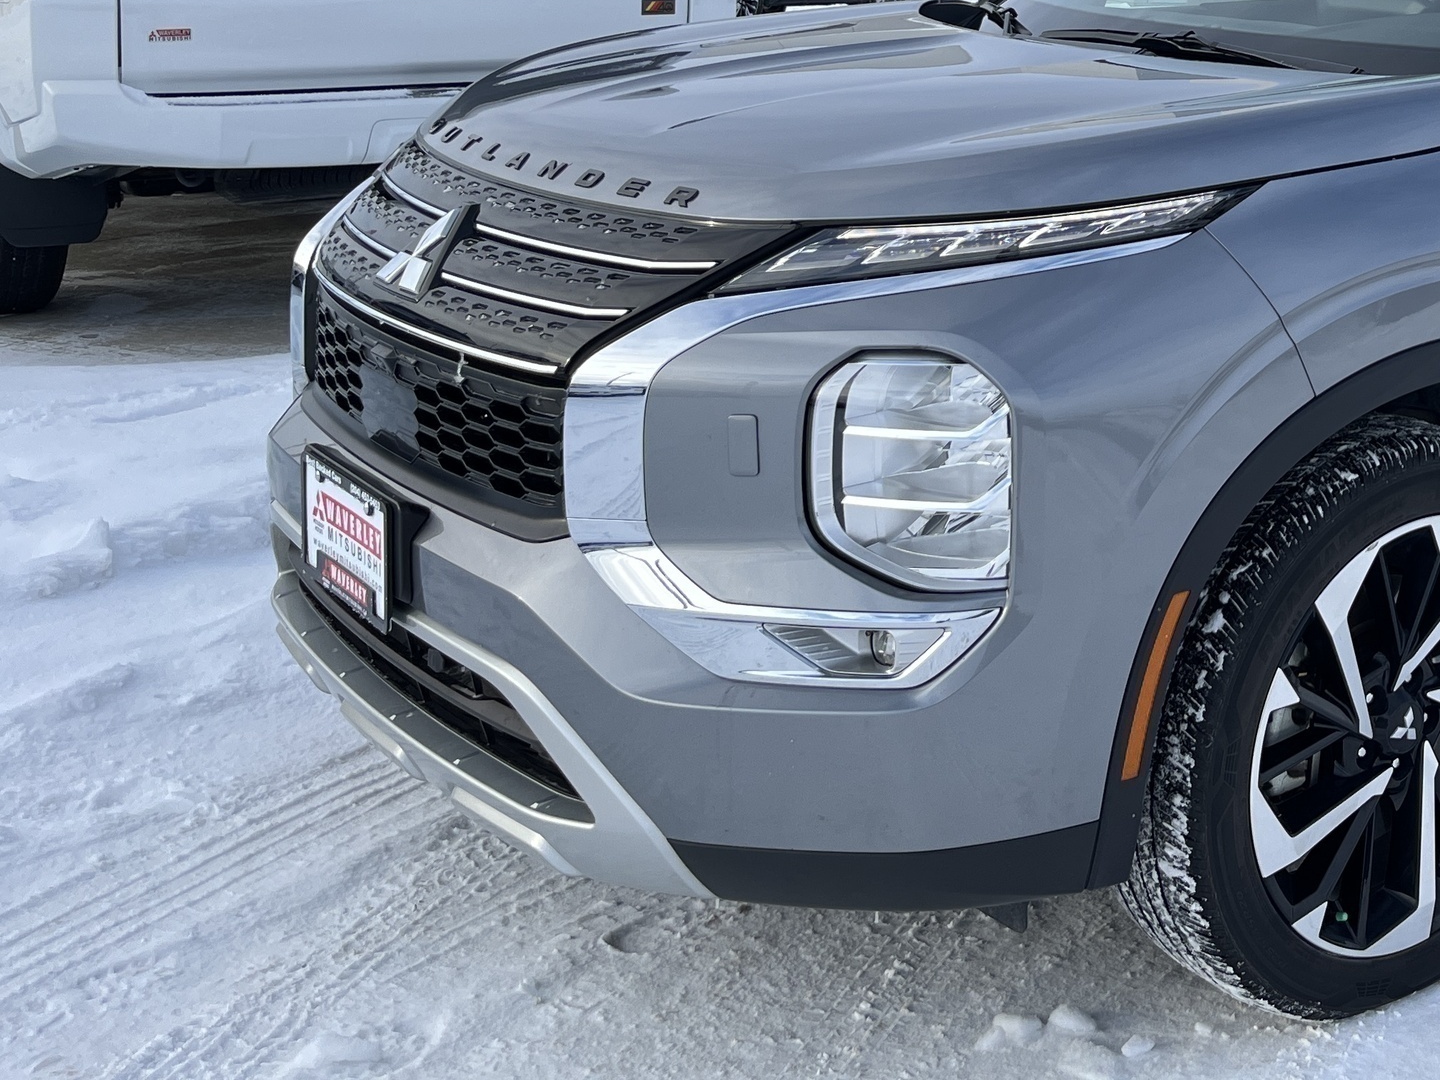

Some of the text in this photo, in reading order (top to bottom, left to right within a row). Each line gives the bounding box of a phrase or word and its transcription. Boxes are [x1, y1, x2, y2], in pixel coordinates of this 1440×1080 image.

[429, 118, 700, 208] OUTLANDER
[325, 498, 381, 557] WAVERLEY
[327, 527, 382, 577] MITSUBISHI
[330, 563, 367, 603] WAVERLEY
